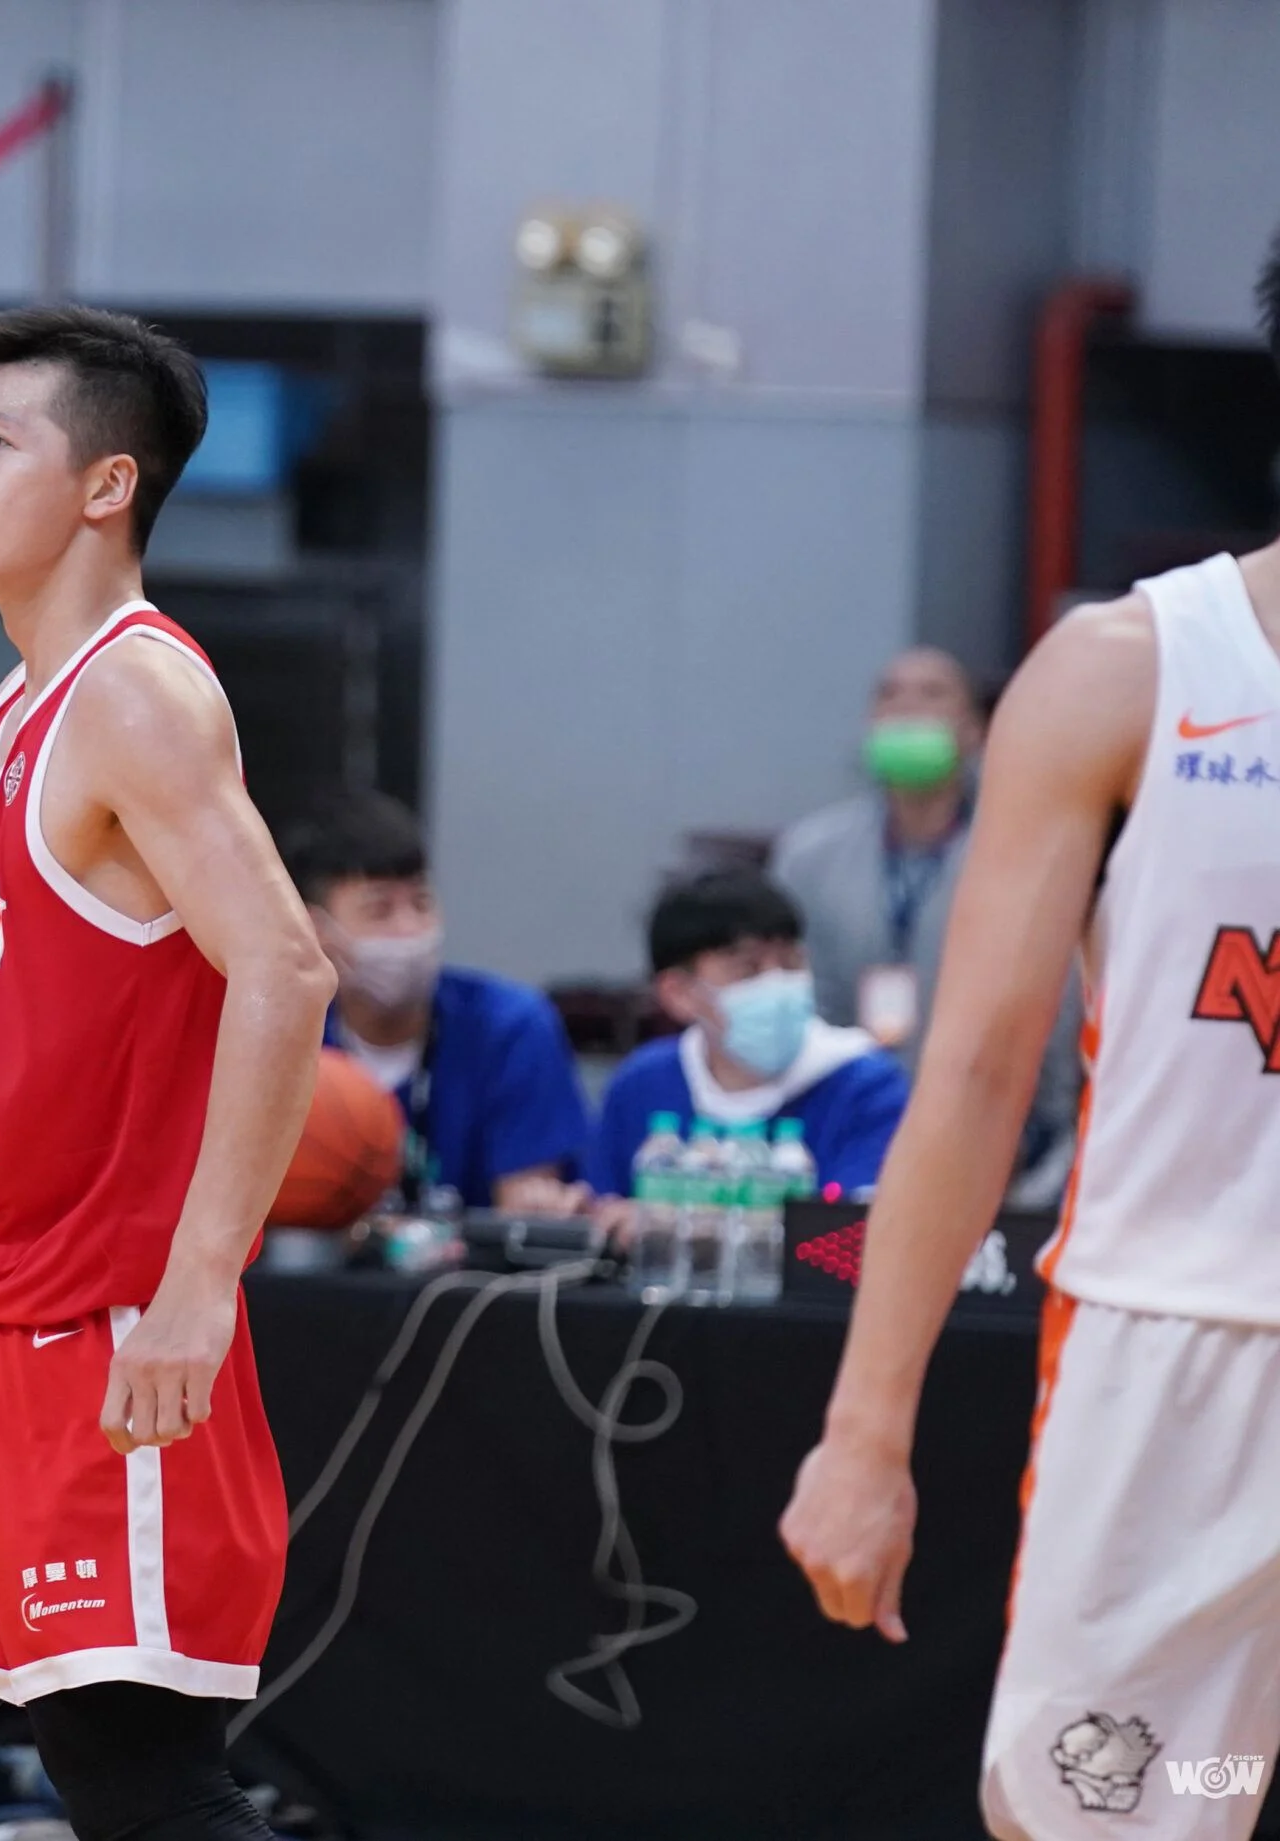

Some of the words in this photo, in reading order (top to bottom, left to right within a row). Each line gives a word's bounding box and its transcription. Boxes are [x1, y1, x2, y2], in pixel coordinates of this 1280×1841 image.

[22, 1559, 98, 1590] 摩曼頓
[29, 1599, 105, 1620] Momentum
